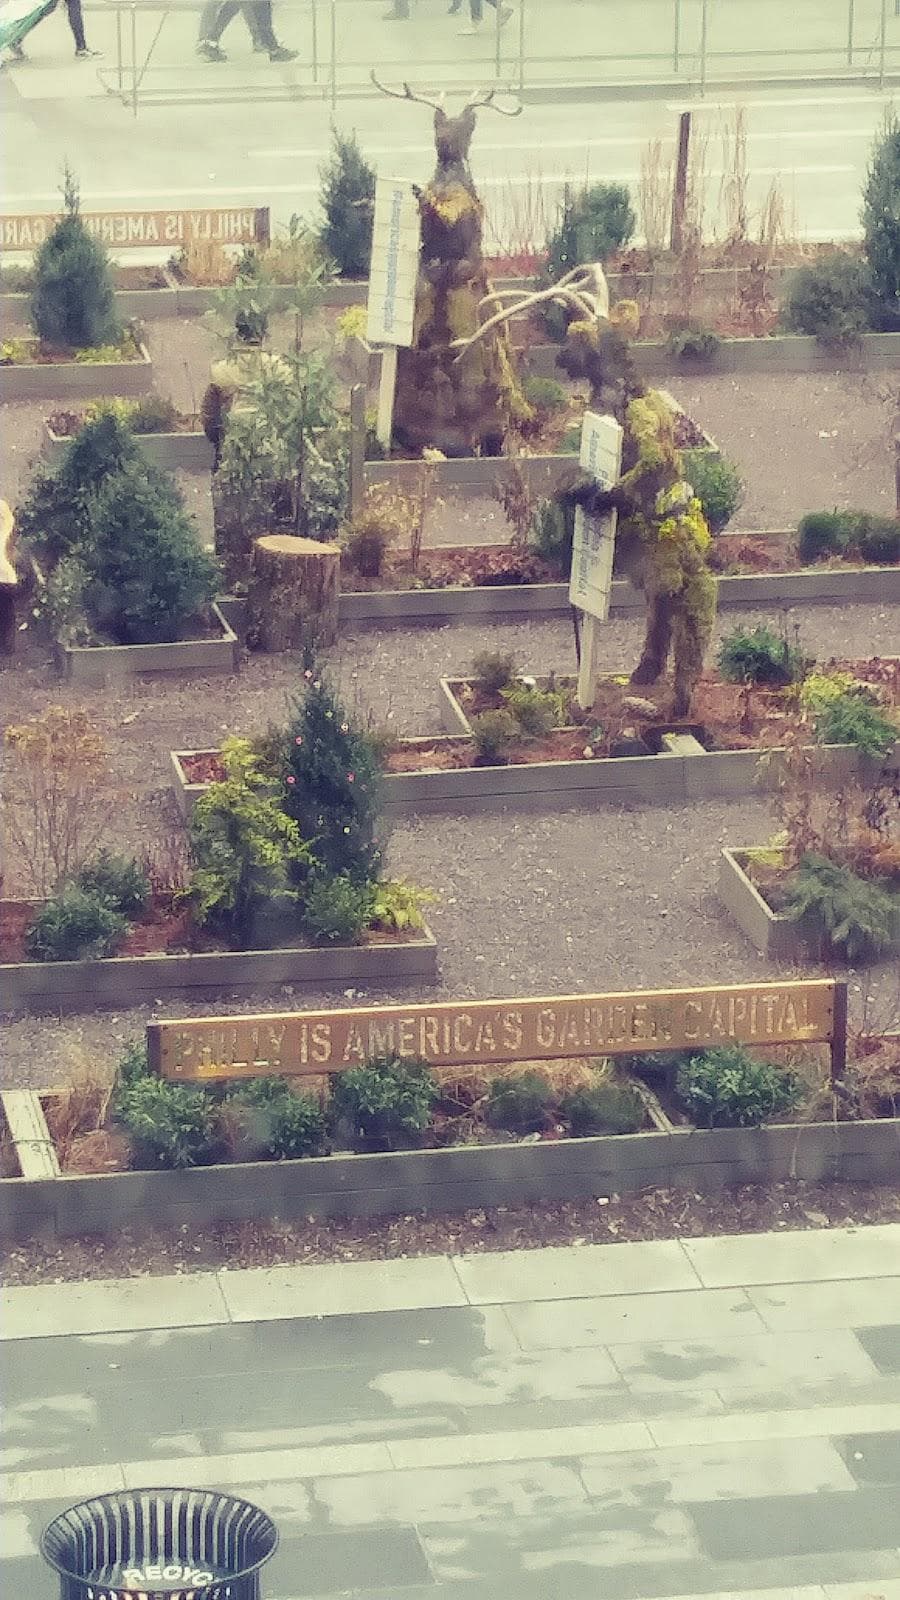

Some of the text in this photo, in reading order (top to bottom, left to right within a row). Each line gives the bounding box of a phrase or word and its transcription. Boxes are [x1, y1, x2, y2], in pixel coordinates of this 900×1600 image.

[174, 993, 819, 1071] PHILLY IS AMERICA'S GARDEN CAPITAL
